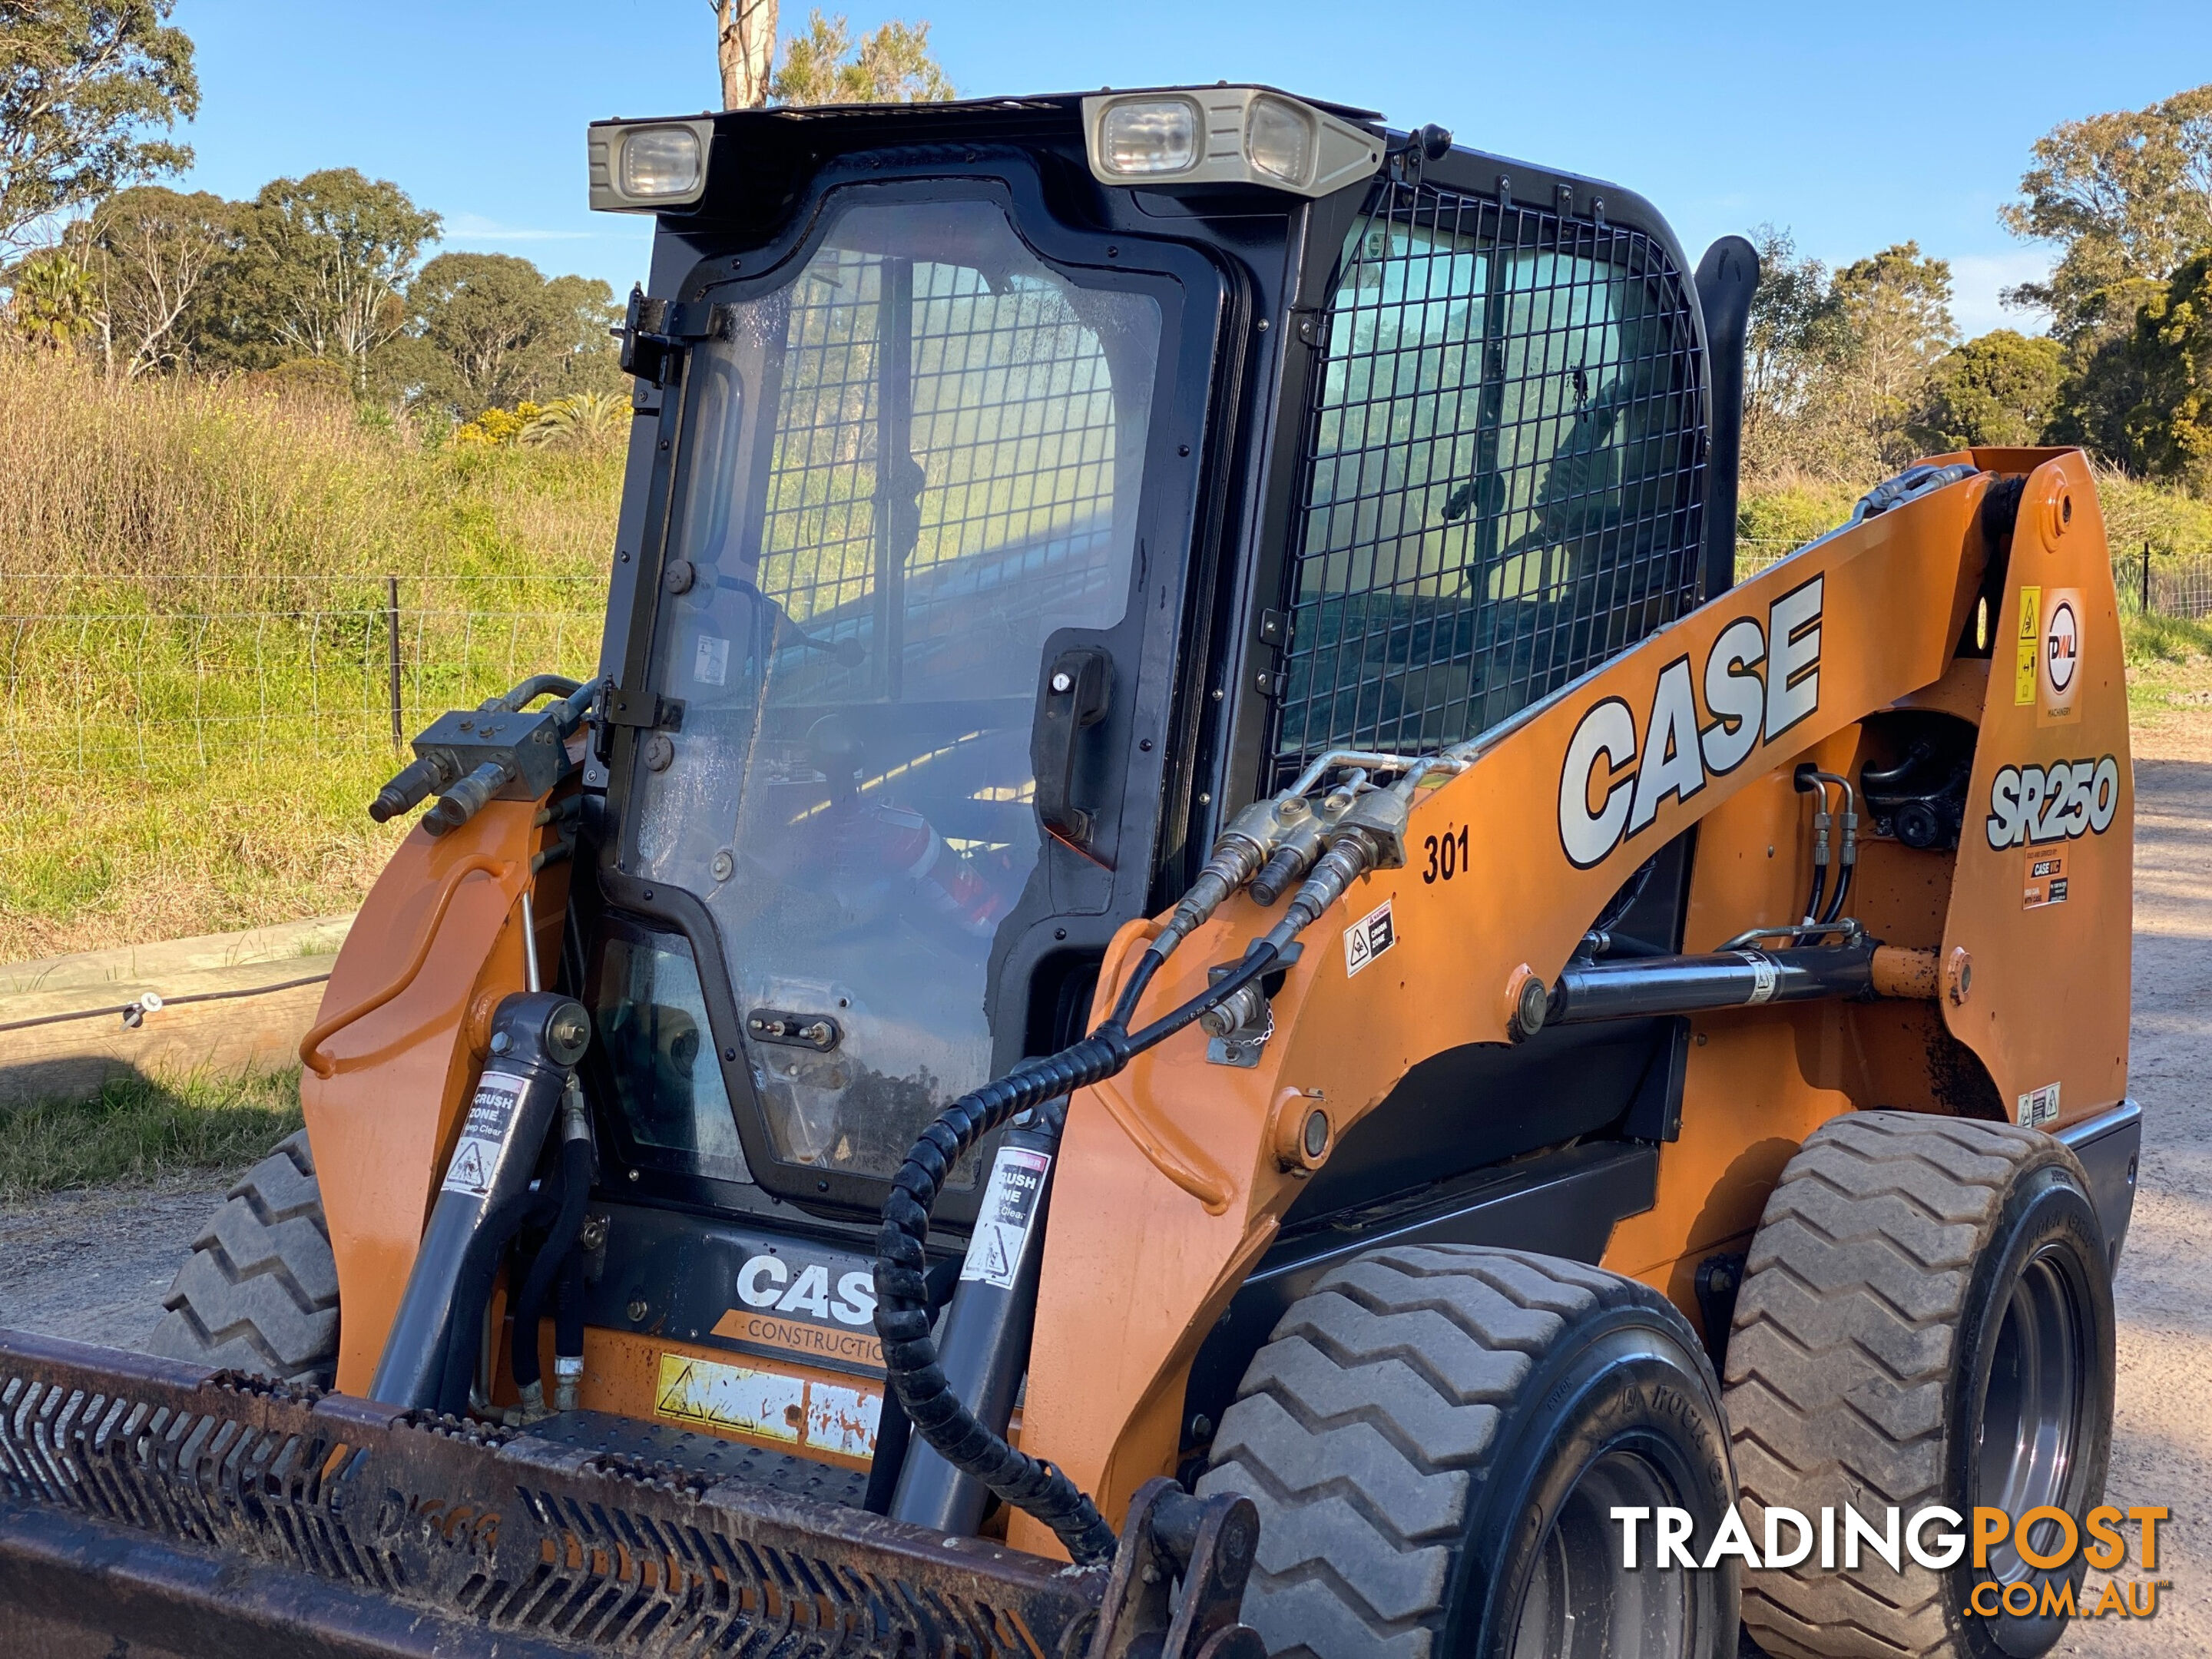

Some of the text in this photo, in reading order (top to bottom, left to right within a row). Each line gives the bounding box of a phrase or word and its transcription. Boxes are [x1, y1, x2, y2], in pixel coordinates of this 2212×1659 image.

[1557, 570, 1824, 870] CASE
[2047, 707, 2071, 718] MACHINERY
[1987, 755, 2118, 849] SR250
[1422, 824, 1469, 884] 301
[2034, 862, 2050, 876] CASE
[1371, 921, 1388, 939] CRUSH
[1372, 933, 1386, 949] ZONE
[475, 1093, 514, 1110] CRUSH
[469, 1108, 499, 1121] ZONE
[479, 1124, 502, 1137] Clear
[999, 1171, 1037, 1190] RUSH
[1001, 1206, 1026, 1220] Clear
[736, 1254, 878, 1325] CAS
[748, 1320, 885, 1363] CONSTRUCTIO
